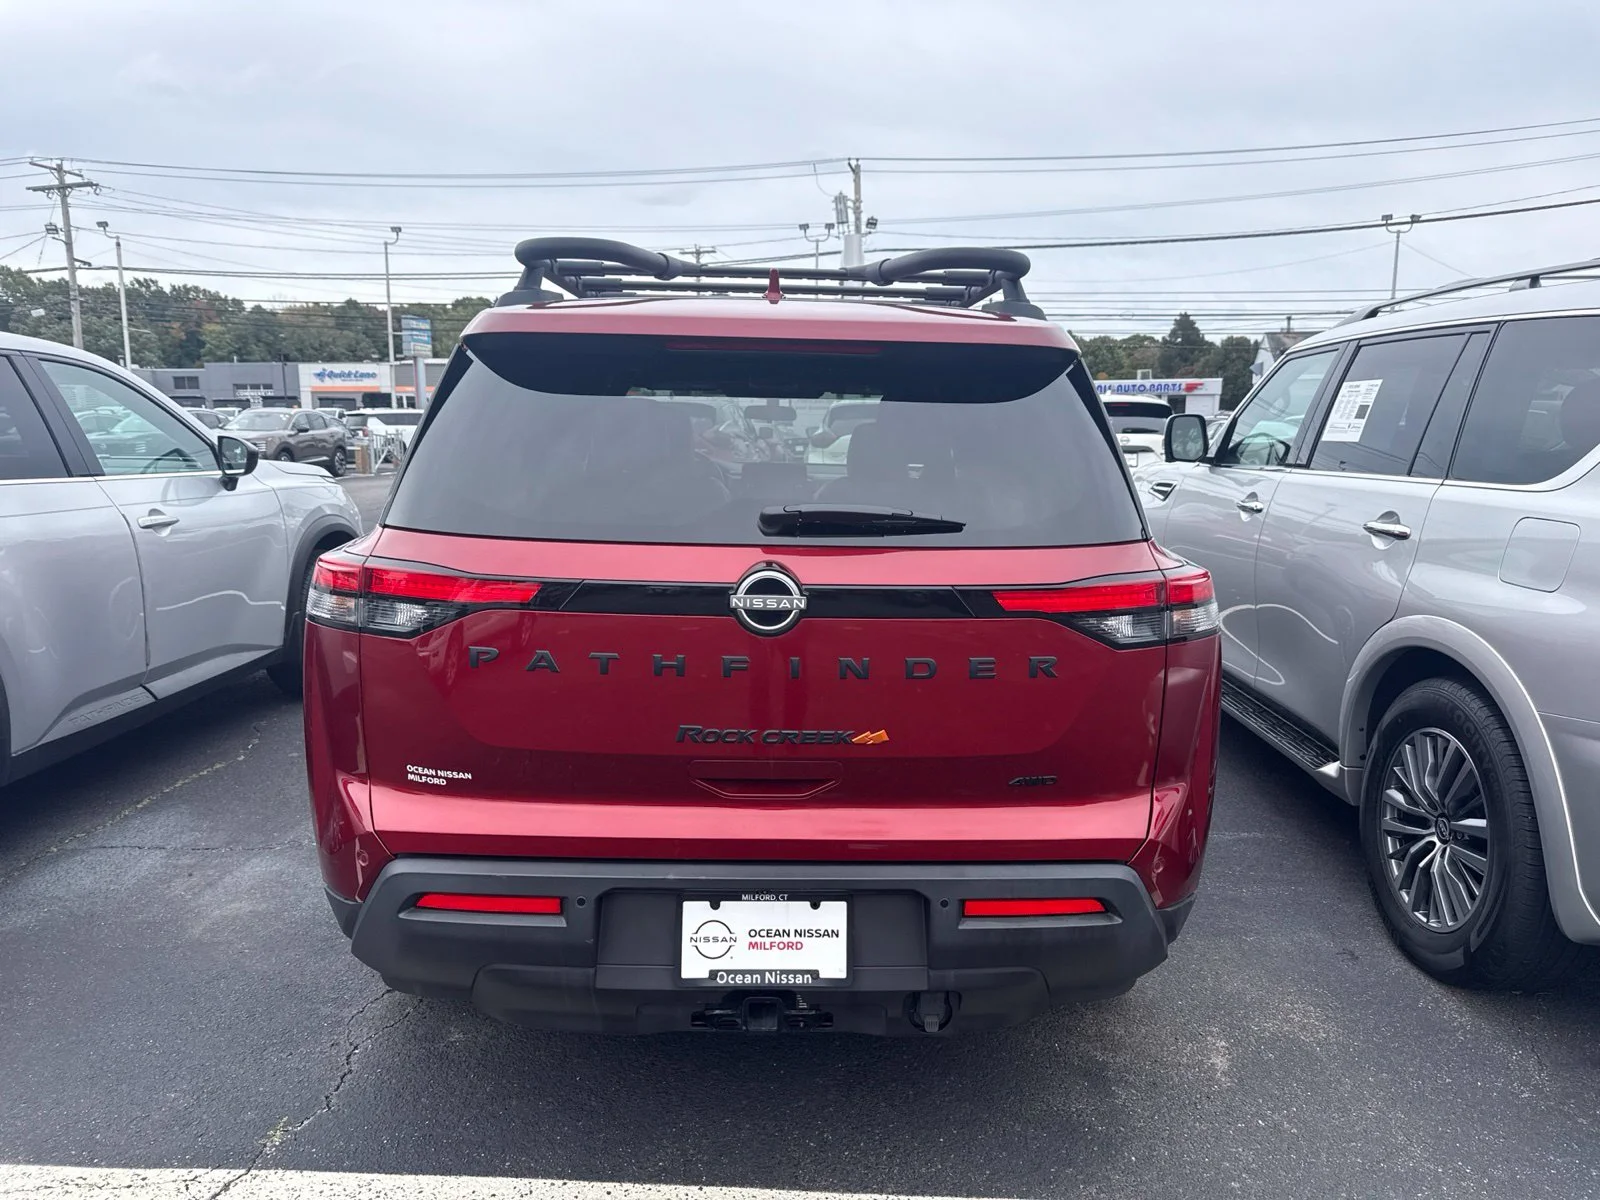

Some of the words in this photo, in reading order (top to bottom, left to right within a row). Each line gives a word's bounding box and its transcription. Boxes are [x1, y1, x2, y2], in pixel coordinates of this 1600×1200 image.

[326, 370, 352, 380] Quick
[1116, 384, 1146, 393] AUTO
[1149, 383, 1183, 392] PARTS
[732, 597, 805, 609] NISSAN
[468, 645, 1059, 680] PATHFINDER
[675, 724, 758, 744] ROCK
[761, 729, 855, 745] CREEK
[406, 764, 436, 776] OCEAN
[437, 769, 472, 780] NISSAN
[407, 773, 447, 786] MILFORD
[748, 928, 791, 938] OCEAN
[793, 928, 840, 938] NISSAN
[748, 941, 804, 951] MILFORD
[716, 971, 761, 984] Ocean
[764, 970, 812, 984] Nissan
